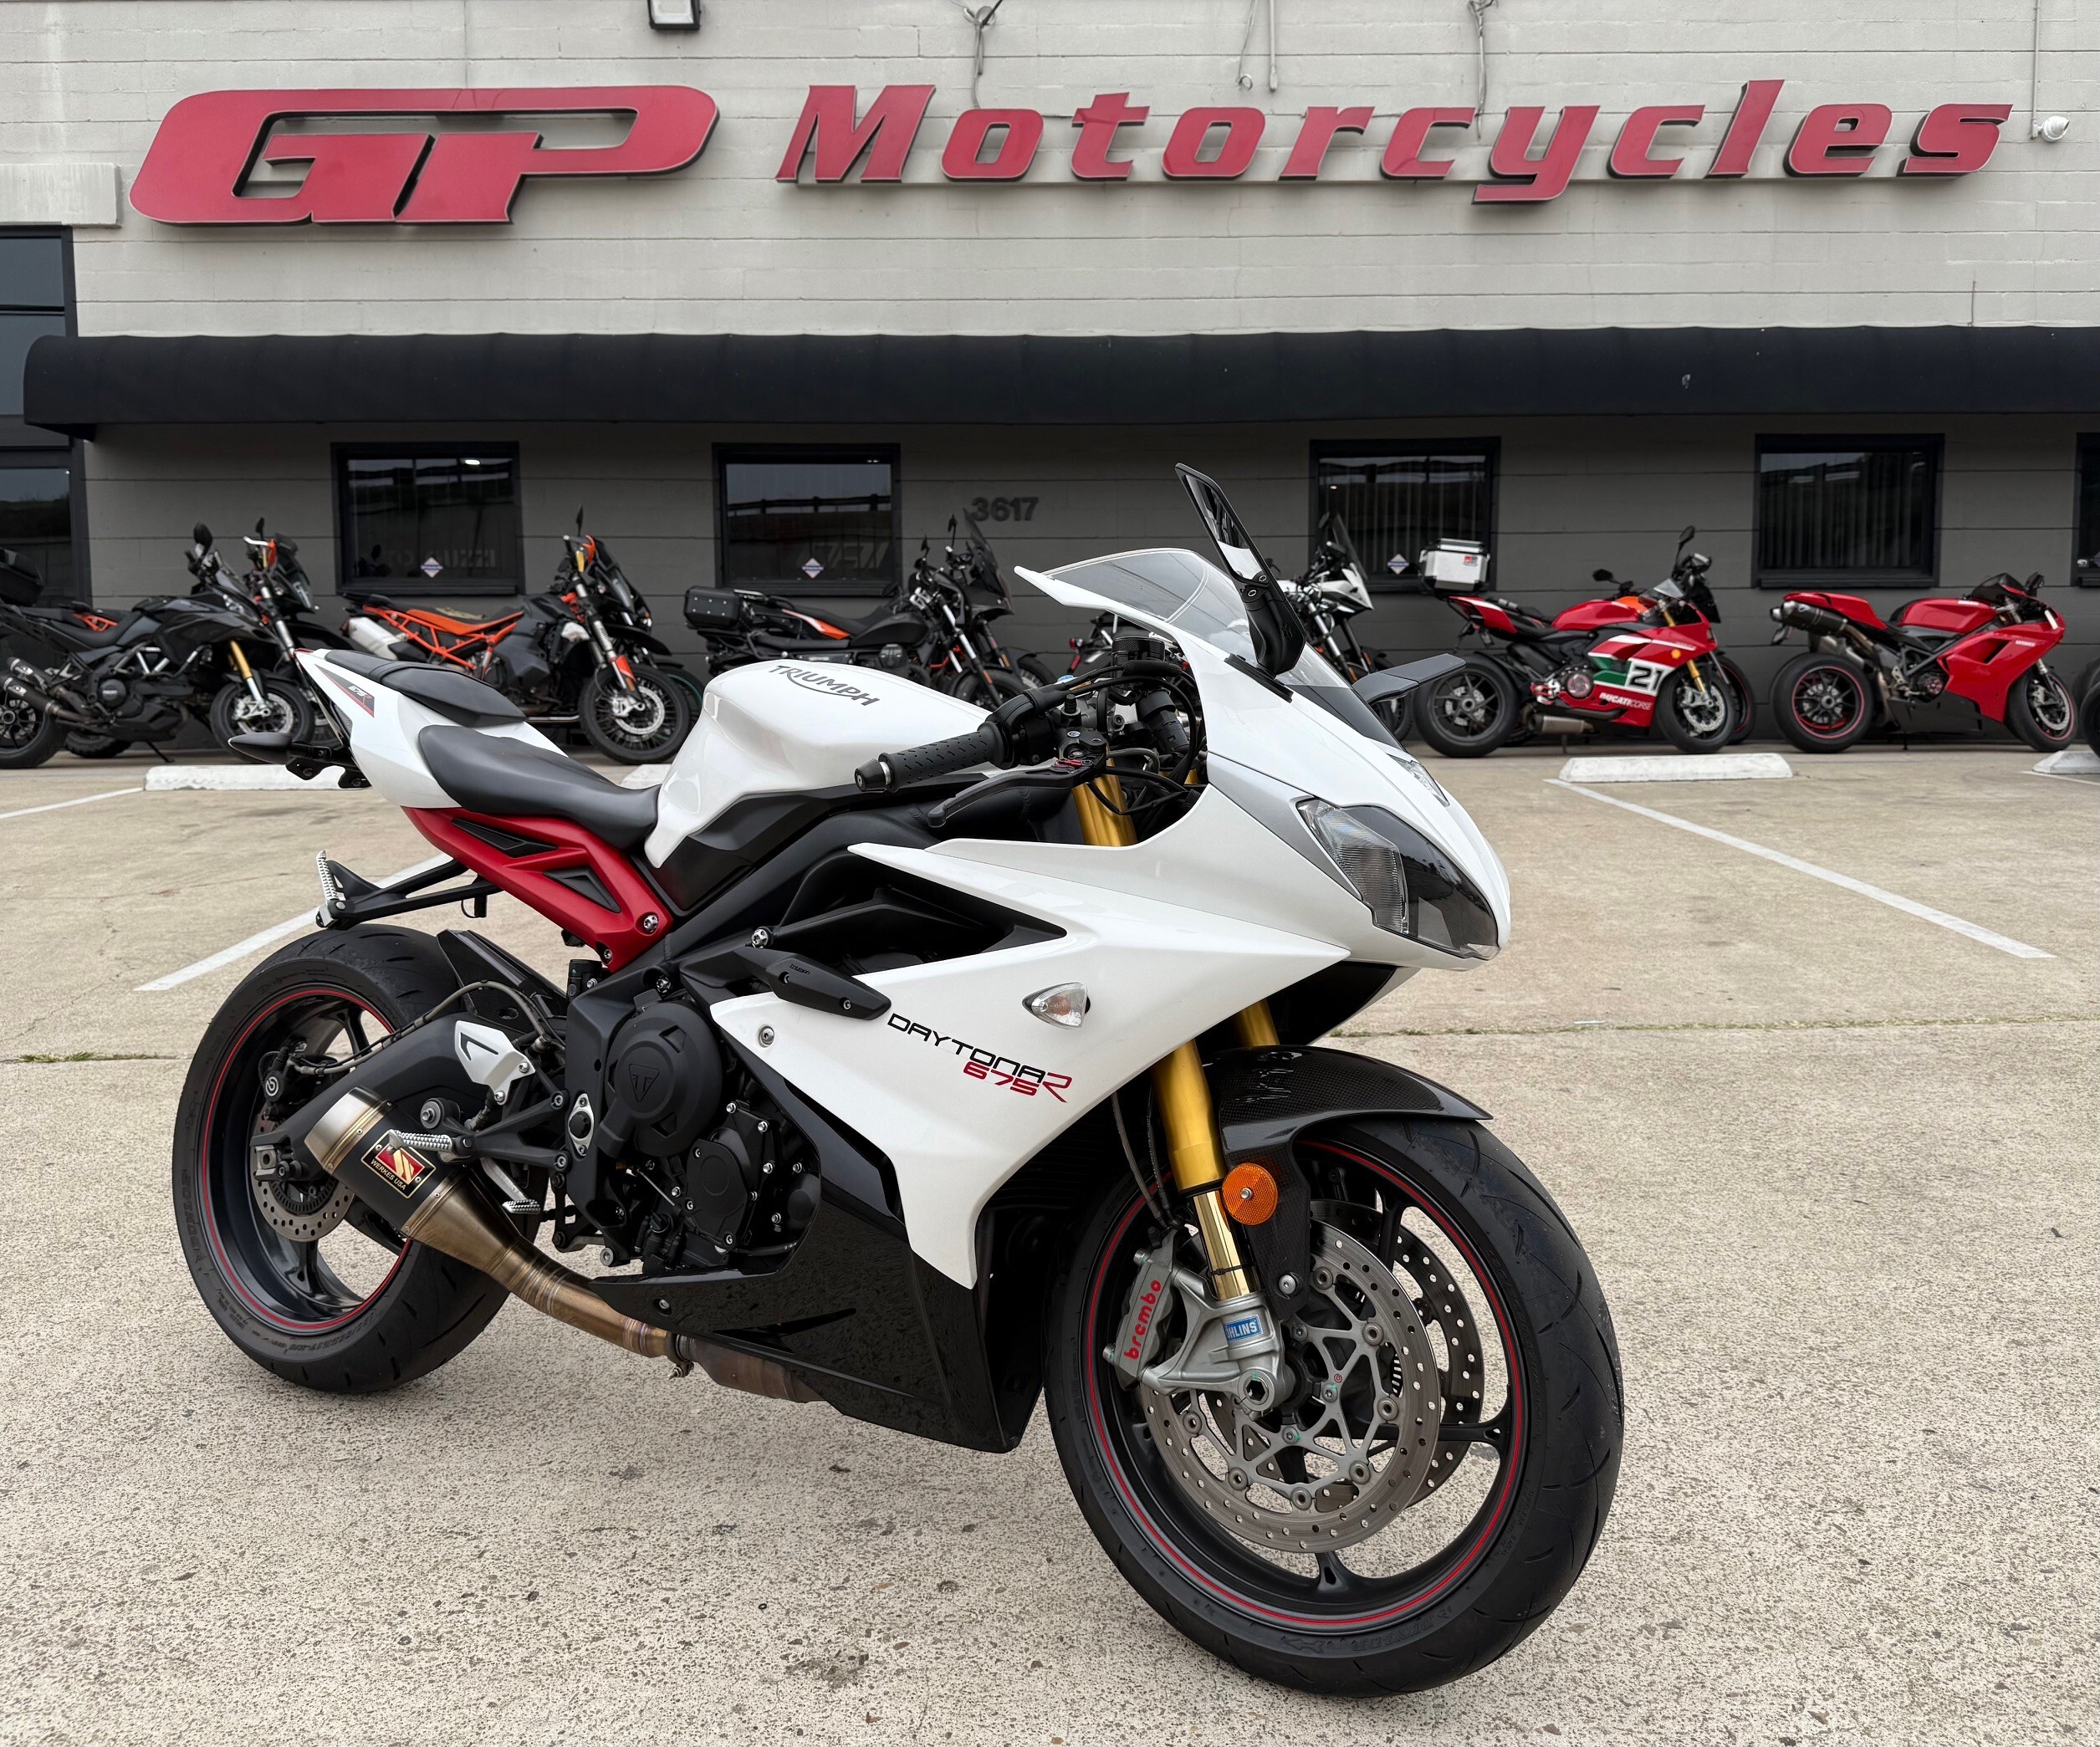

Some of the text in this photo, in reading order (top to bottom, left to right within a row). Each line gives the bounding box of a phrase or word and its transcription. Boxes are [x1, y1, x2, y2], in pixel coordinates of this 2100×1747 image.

[130, 79, 2013, 225] GP Motorcycles
[971, 497, 1039, 522] 3617
[769, 665, 881, 706] TRIUMPH
[1629, 666, 1663, 690] 21
[370, 1158, 407, 1191] WERKES USA
[1123, 1280, 1162, 1360] brembo
